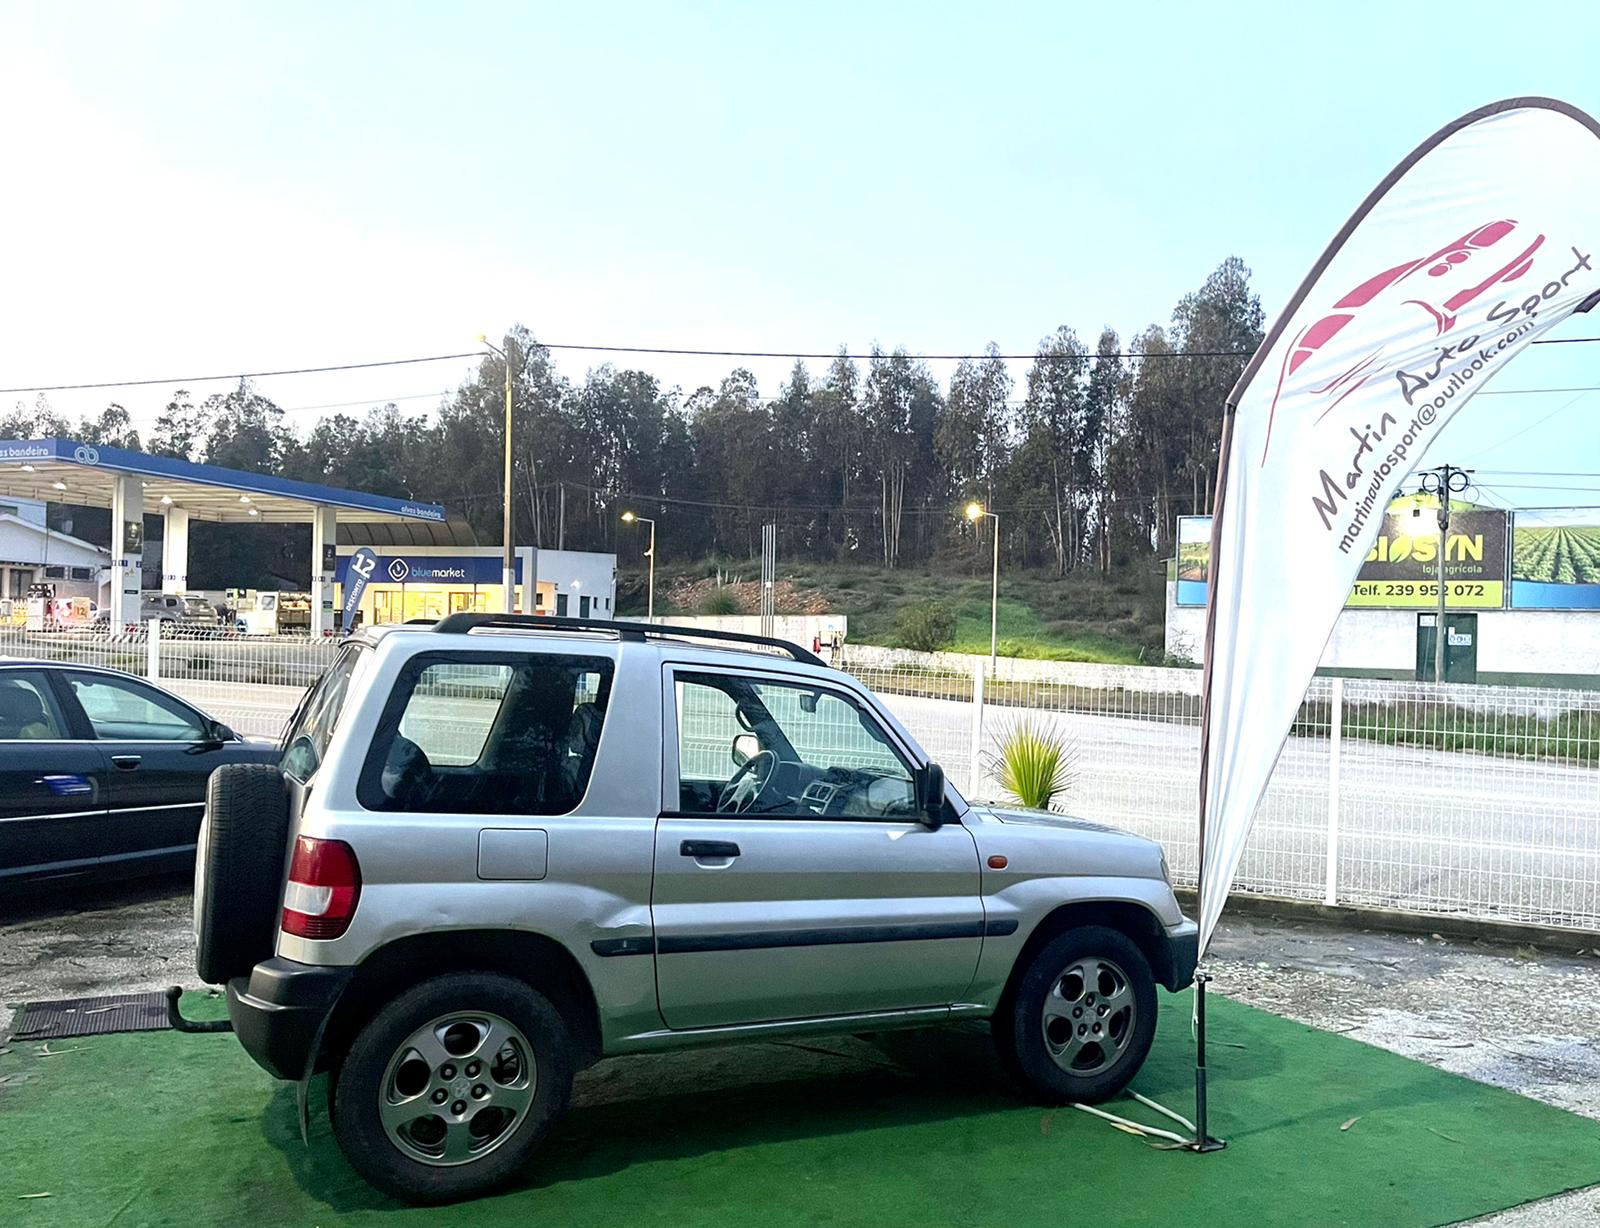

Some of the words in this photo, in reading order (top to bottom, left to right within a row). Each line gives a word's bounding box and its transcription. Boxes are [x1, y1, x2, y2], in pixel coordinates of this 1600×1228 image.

[1312, 412, 1397, 531] Martin
[1396, 335, 1481, 405] Auto
[1486, 246, 1592, 326] Sport
[1338, 319, 1536, 554] martinautosport@outlook.com
[351, 553, 376, 579] 12
[411, 567, 465, 578] bluemarket
[345, 578, 364, 612] DESCONTO
[1353, 584, 1381, 596] Telf.
[1385, 584, 1415, 596] 239
[1419, 585, 1449, 597] 952
[1454, 585, 1484, 597] 072
